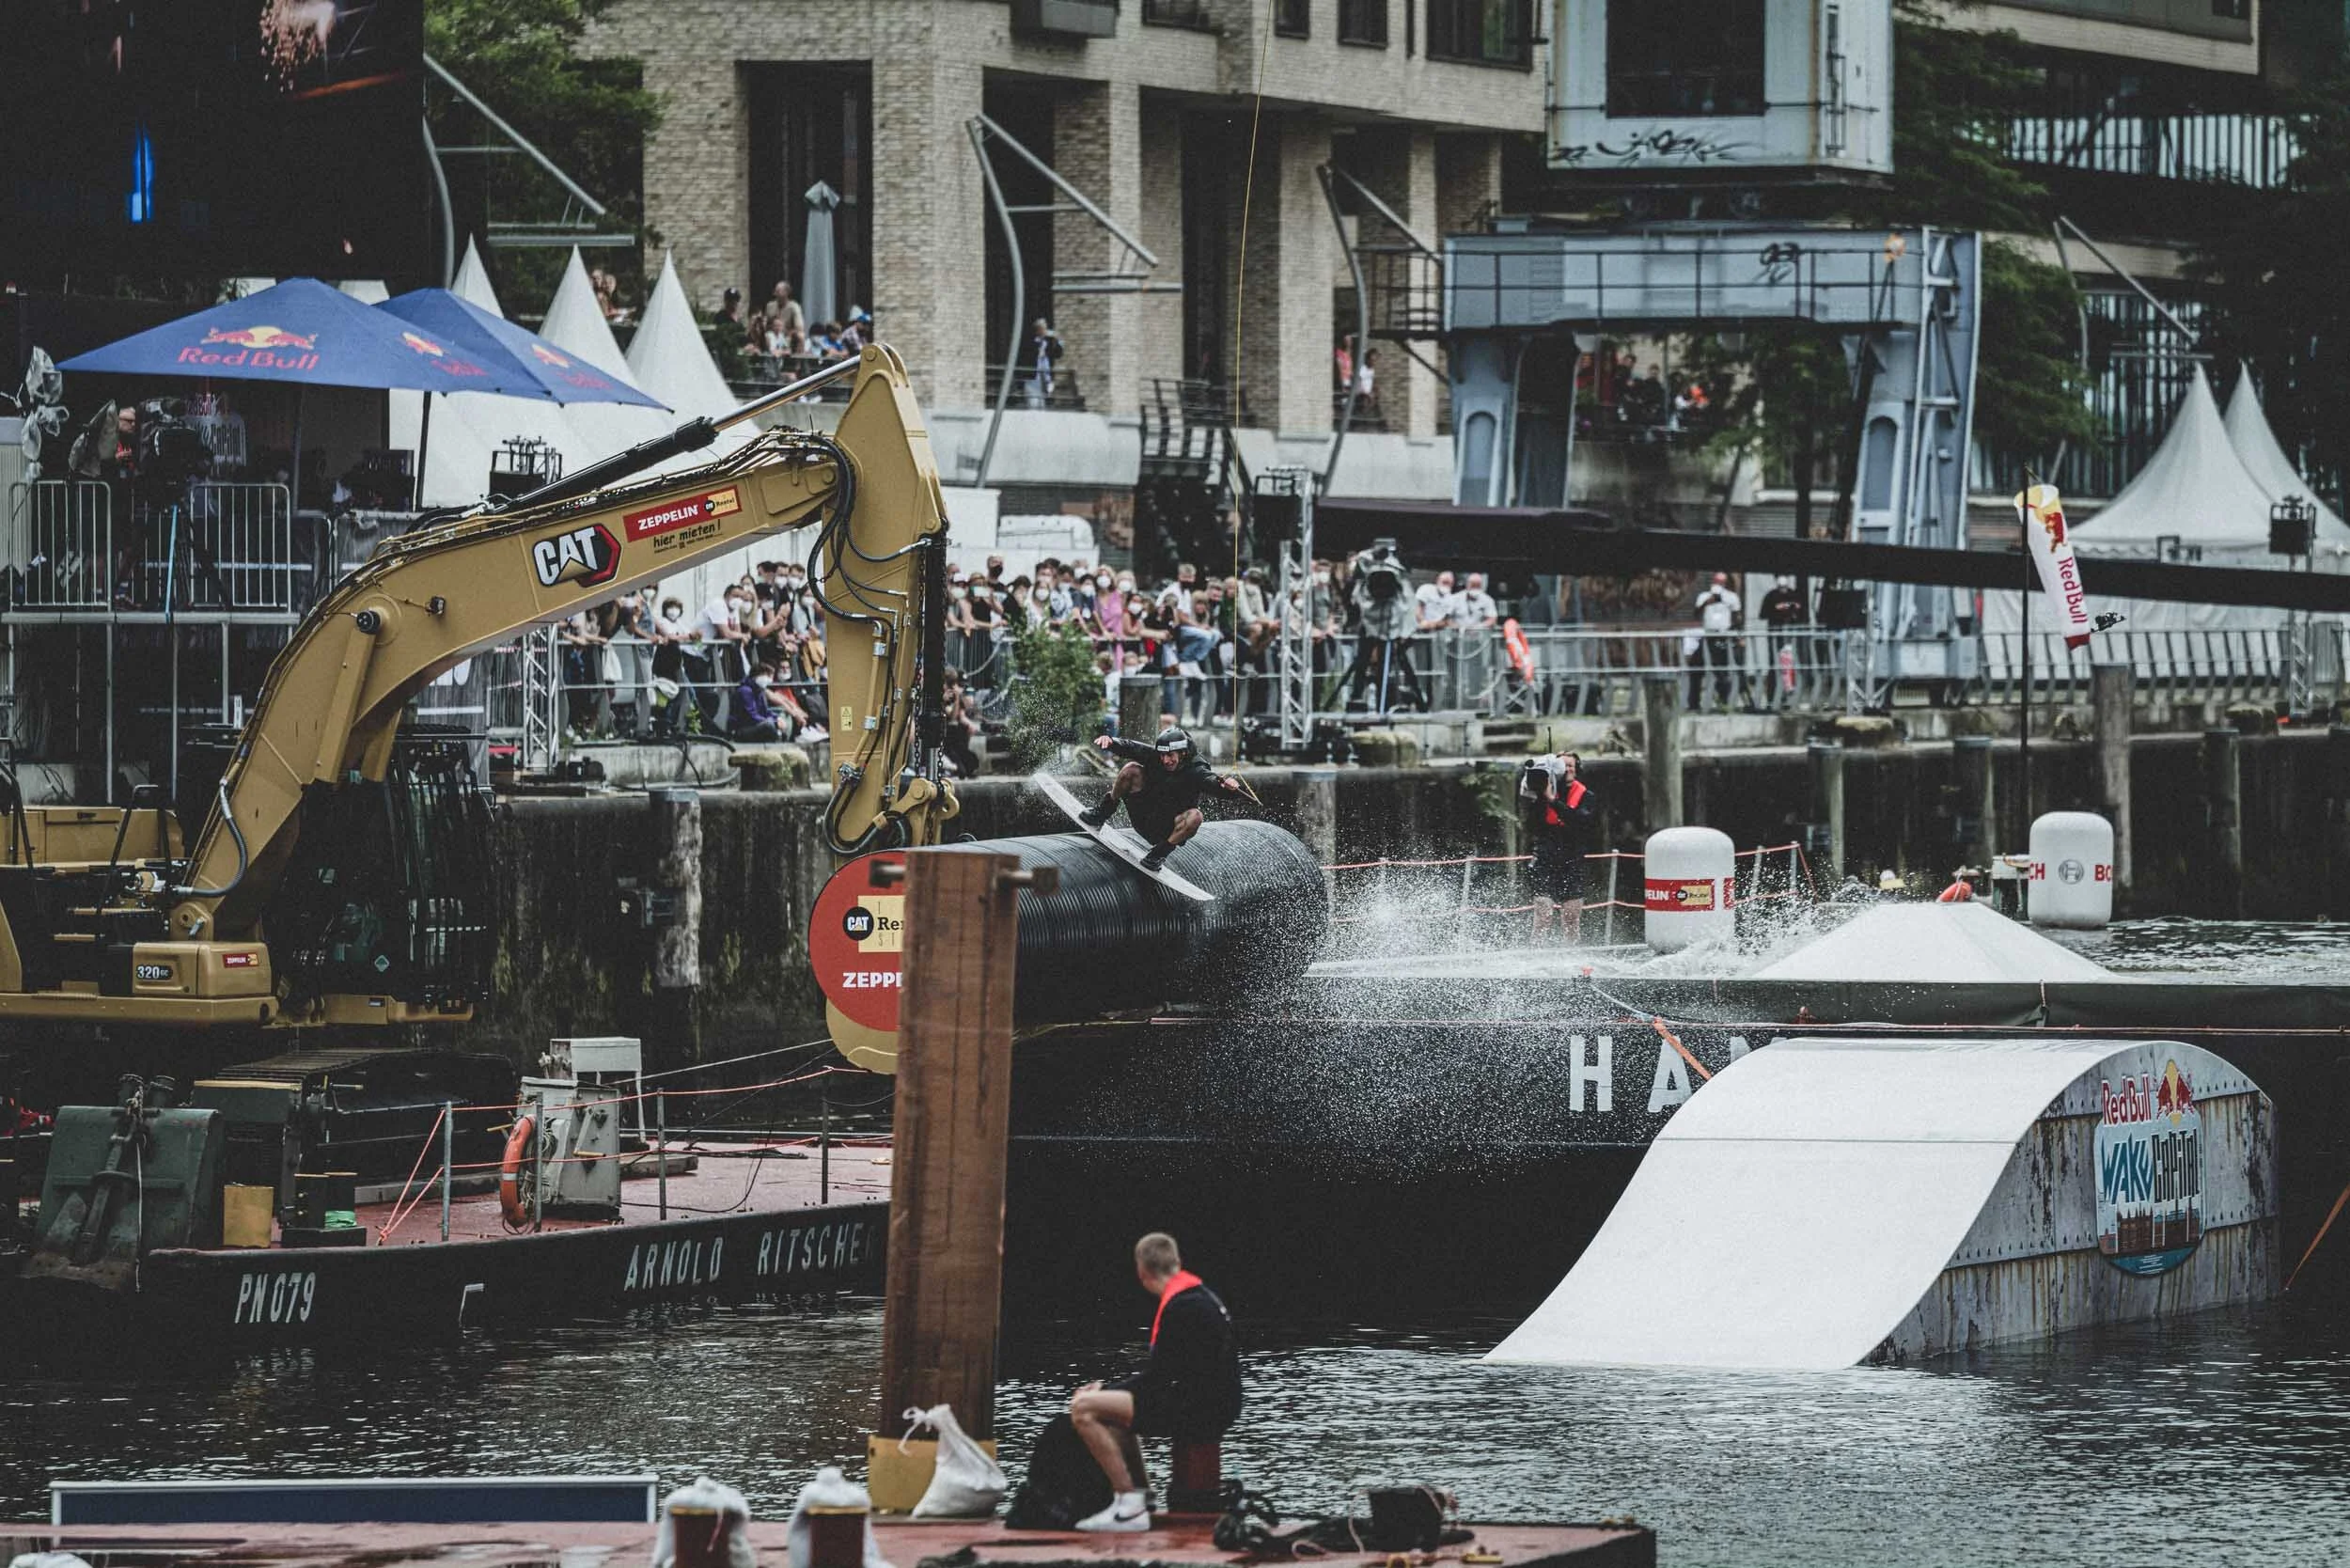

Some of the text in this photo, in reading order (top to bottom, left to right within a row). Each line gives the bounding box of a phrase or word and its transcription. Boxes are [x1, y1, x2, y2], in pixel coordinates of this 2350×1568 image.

[178, 346, 320, 370] Red Bull
[637, 504, 698, 530] ZEPPELIN
[653, 533, 675, 547] hier
[534, 526, 598, 585] CAT
[2058, 557, 2088, 624] Red Bull
[847, 917, 904, 931] CAT Re
[137, 965, 160, 979] 320
[2101, 1072, 2151, 1126] Red Bull
[623, 1236, 724, 1291] ARNOLD
